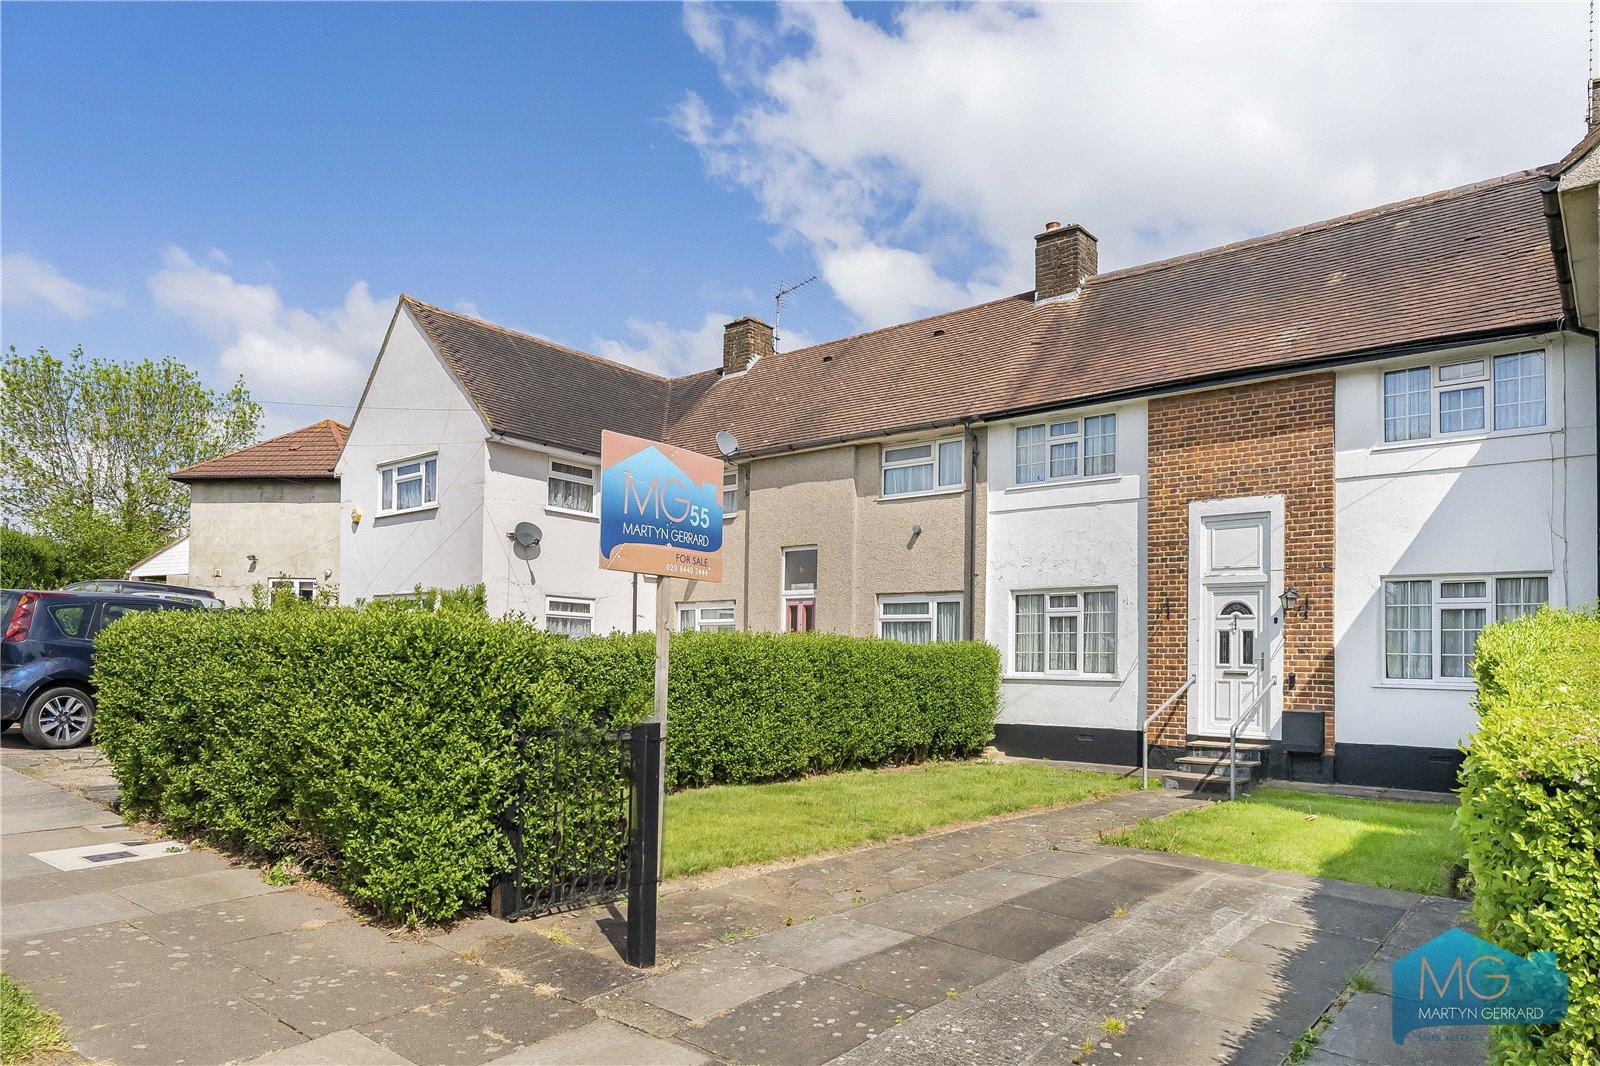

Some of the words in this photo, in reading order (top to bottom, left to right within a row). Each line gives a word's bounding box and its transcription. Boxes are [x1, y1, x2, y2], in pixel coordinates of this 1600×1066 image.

[623, 471, 690, 523] MG
[690, 505, 710, 528] 55
[623, 522, 669, 541] MARTYN
[670, 529, 709, 547] GERRARD
[666, 563, 678, 573] 020
[679, 565, 694, 575] 8440
[676, 553, 691, 565] FOR
[692, 556, 709, 567] SALE
